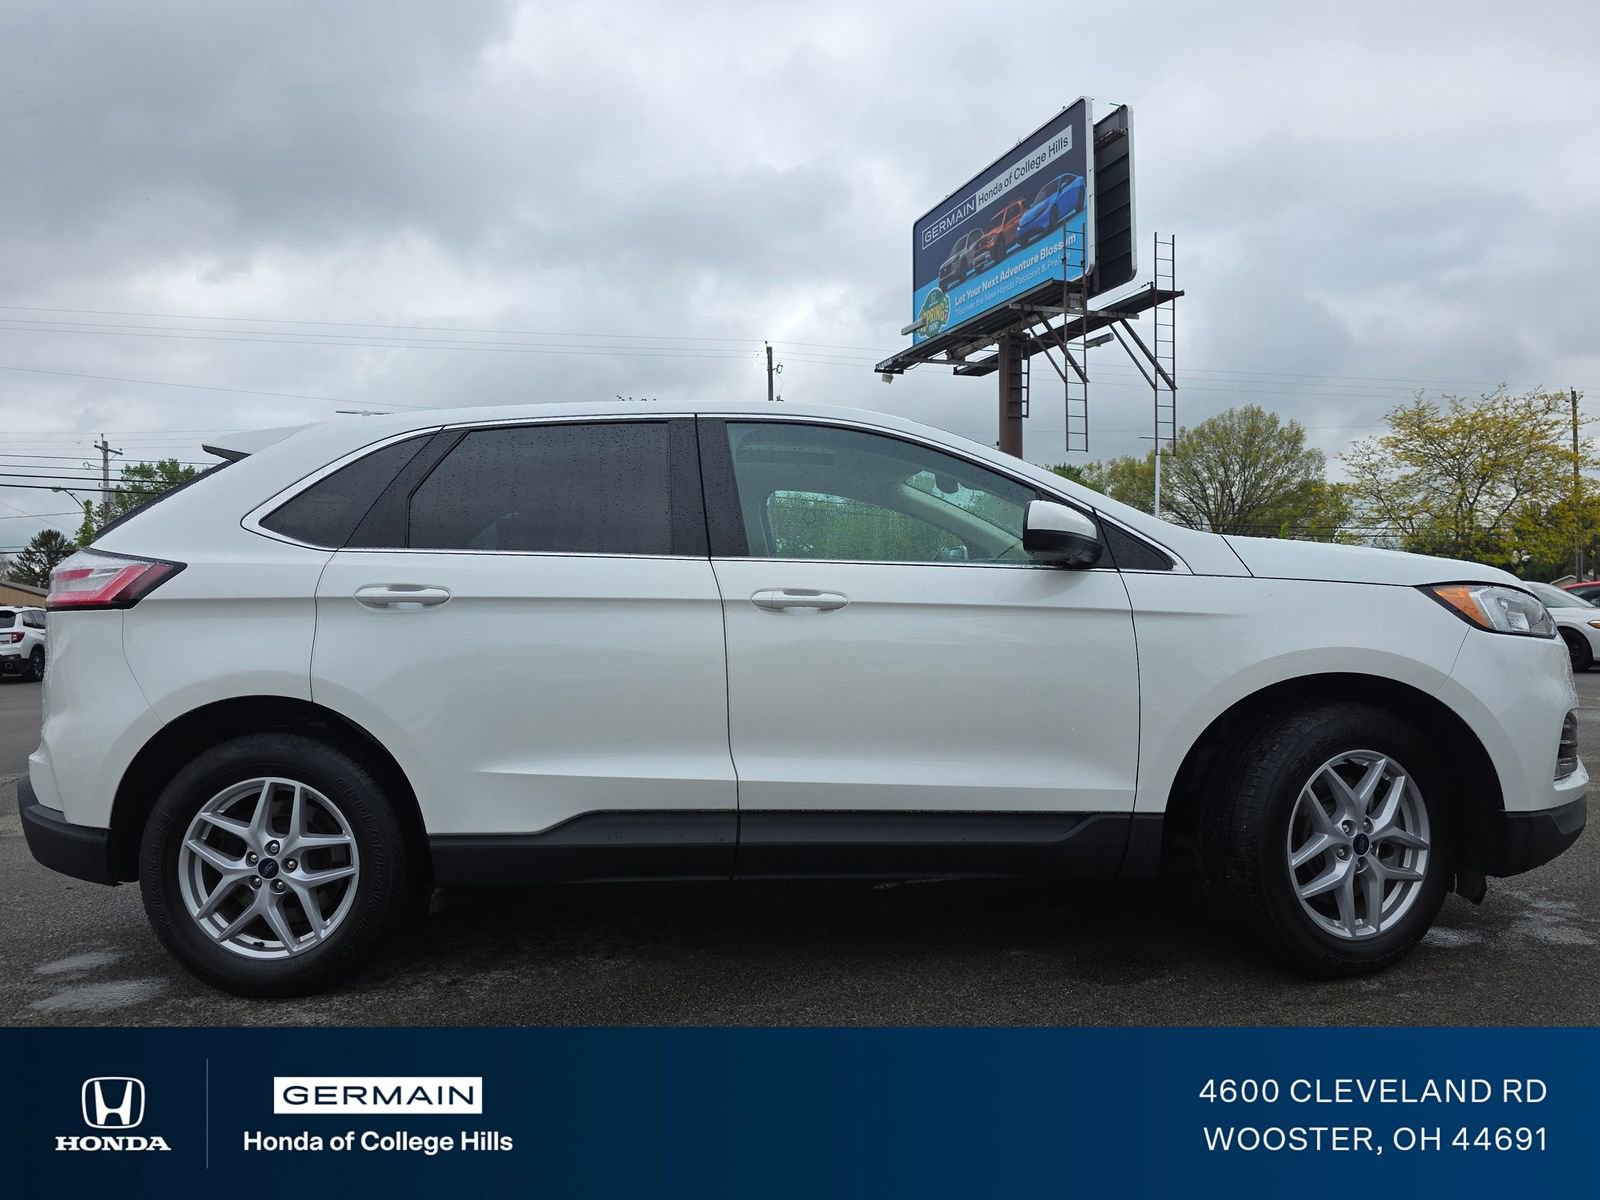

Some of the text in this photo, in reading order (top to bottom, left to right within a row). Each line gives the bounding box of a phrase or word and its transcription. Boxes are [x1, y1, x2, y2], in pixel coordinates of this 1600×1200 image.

[924, 136, 1069, 243] GERMAIN Honda of College Hills
[955, 293, 966, 306] Let
[966, 286, 981, 299] Your
[981, 275, 999, 292] Next
[1000, 254, 1039, 282] Adventure
